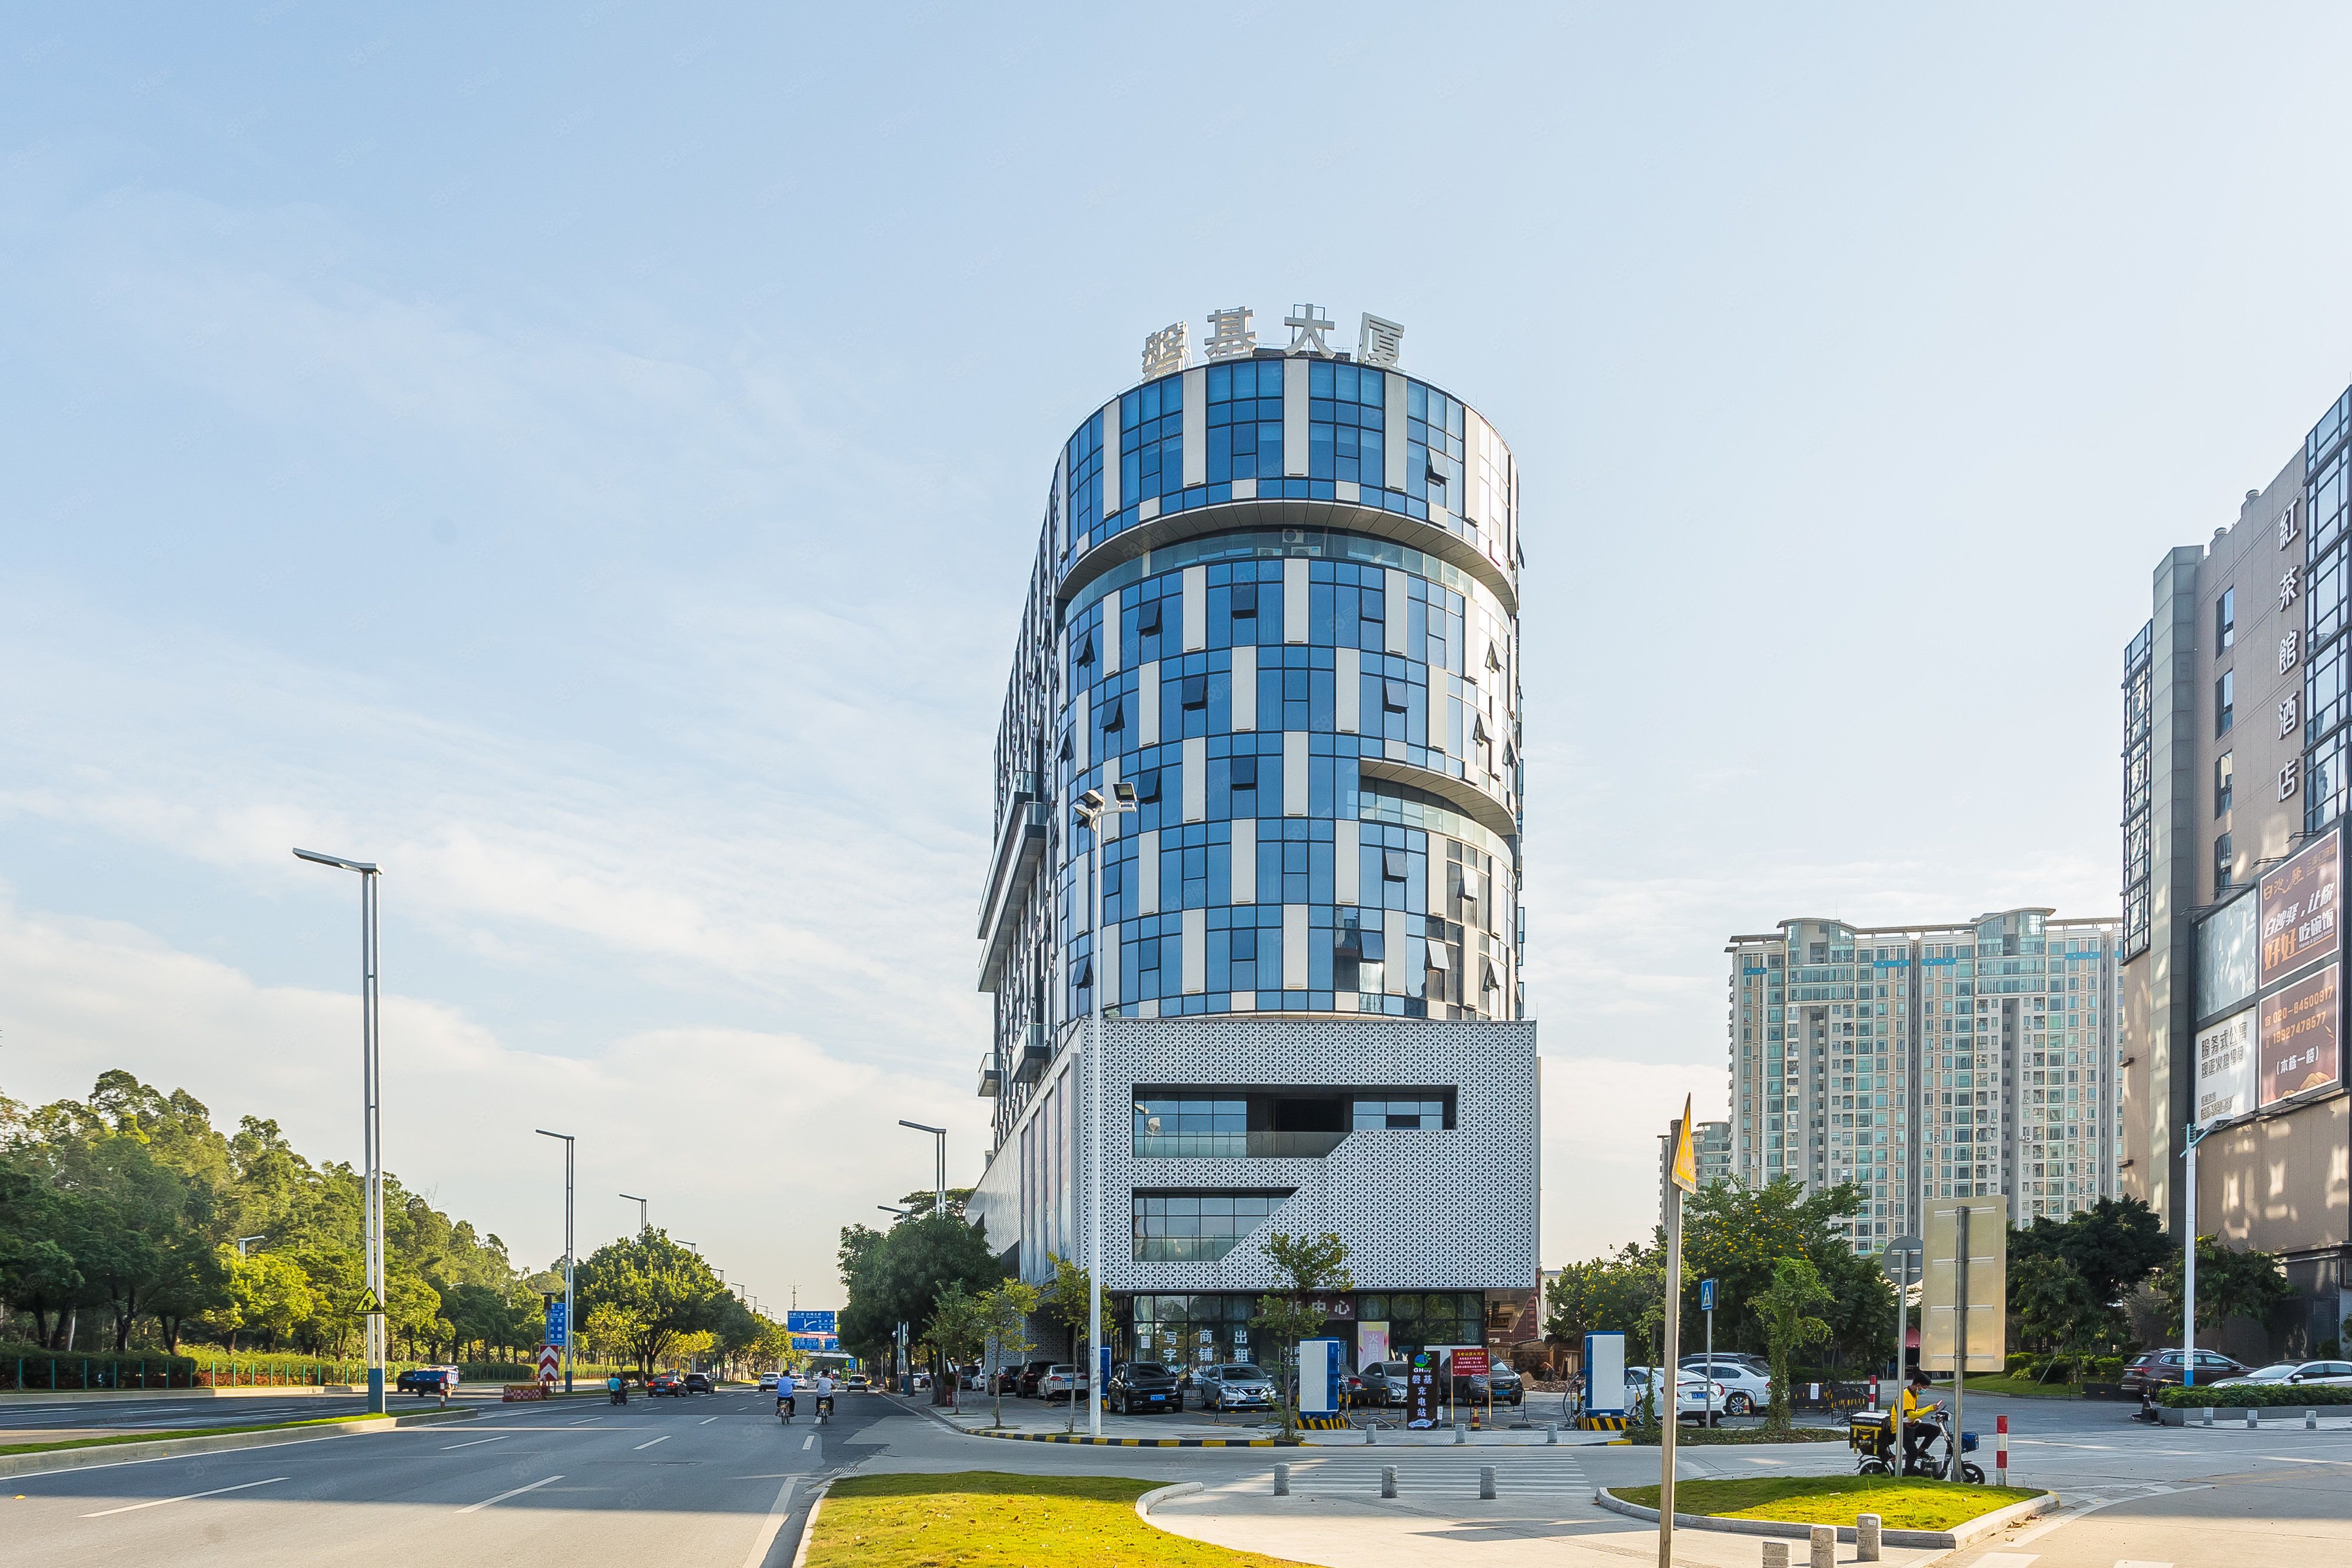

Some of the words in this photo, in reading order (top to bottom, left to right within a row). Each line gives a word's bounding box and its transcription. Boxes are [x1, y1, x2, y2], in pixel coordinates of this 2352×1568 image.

[2278, 497, 2301, 803] 紅茶館酒店
[2201, 1022, 2247, 1060] 服务式公寓
